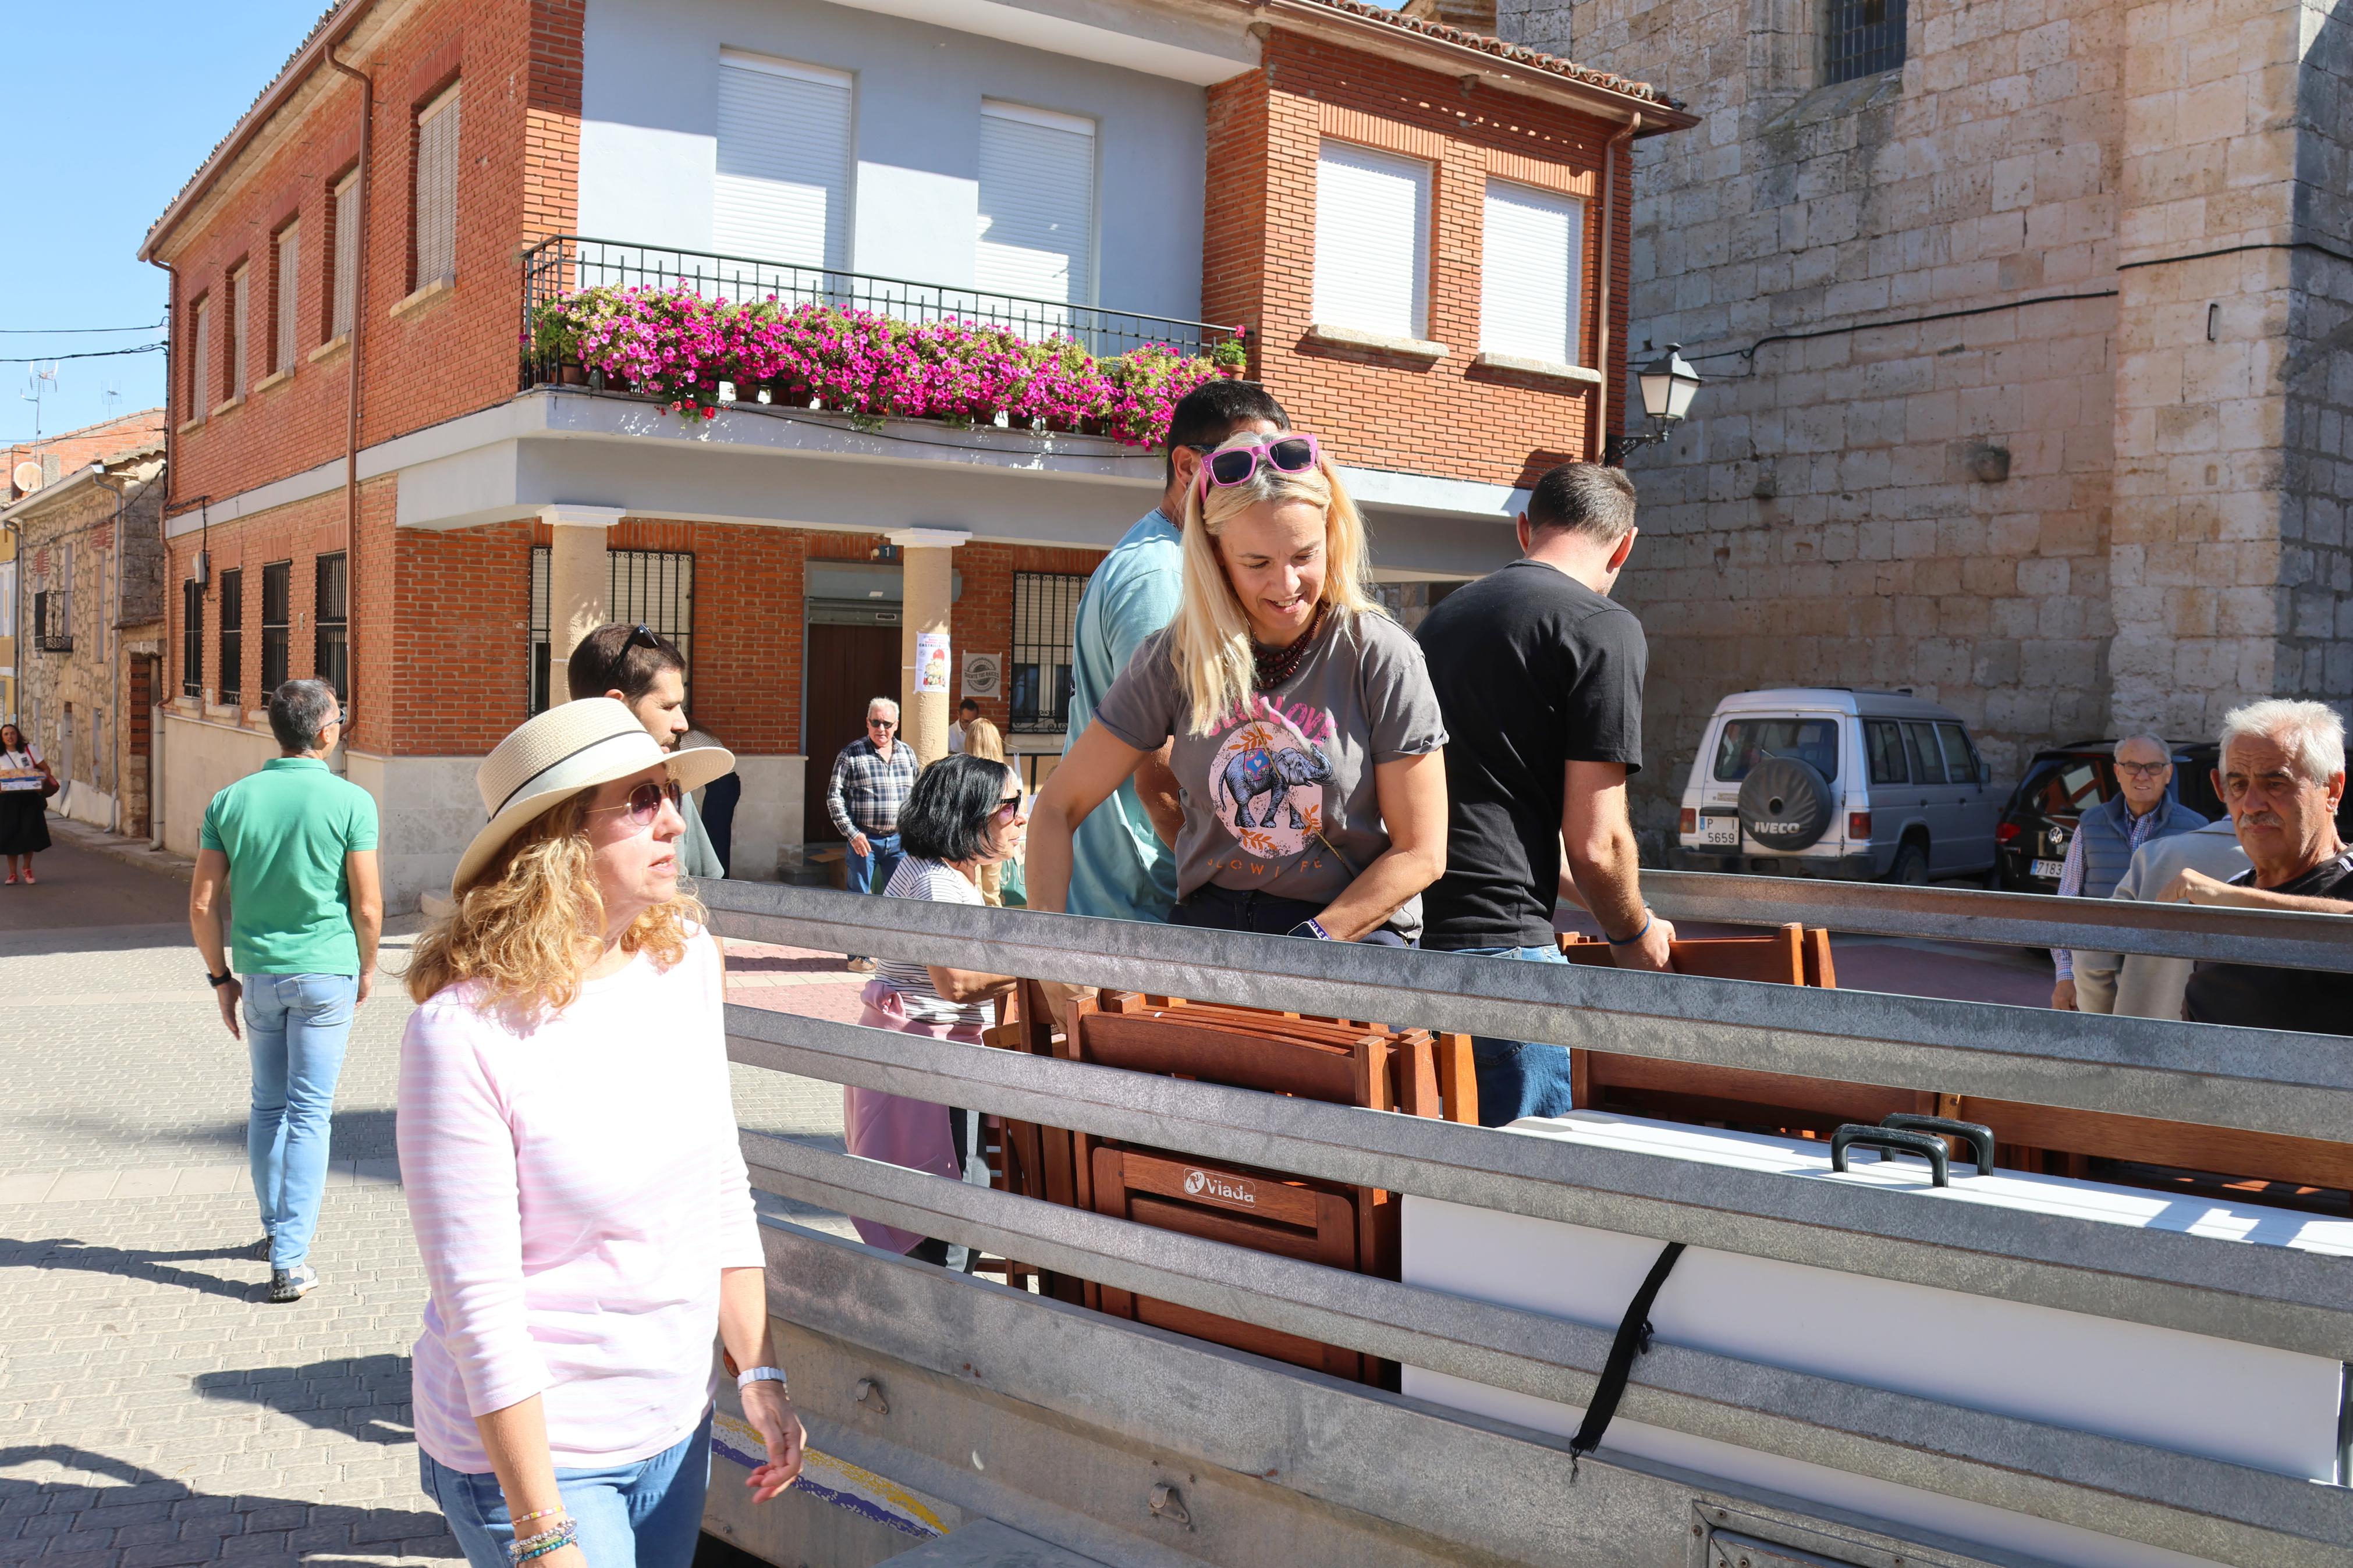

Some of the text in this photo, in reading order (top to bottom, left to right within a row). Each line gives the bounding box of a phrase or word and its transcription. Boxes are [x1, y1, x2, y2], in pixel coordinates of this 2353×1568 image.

[885, 546, 889, 557] 1
[1708, 819, 1713, 829] P
[1754, 822, 1800, 834] IVECO
[1708, 833, 1734, 843] 5659
[2037, 862, 2063, 875] 7183
[1206, 1178, 1254, 1203] Viada
